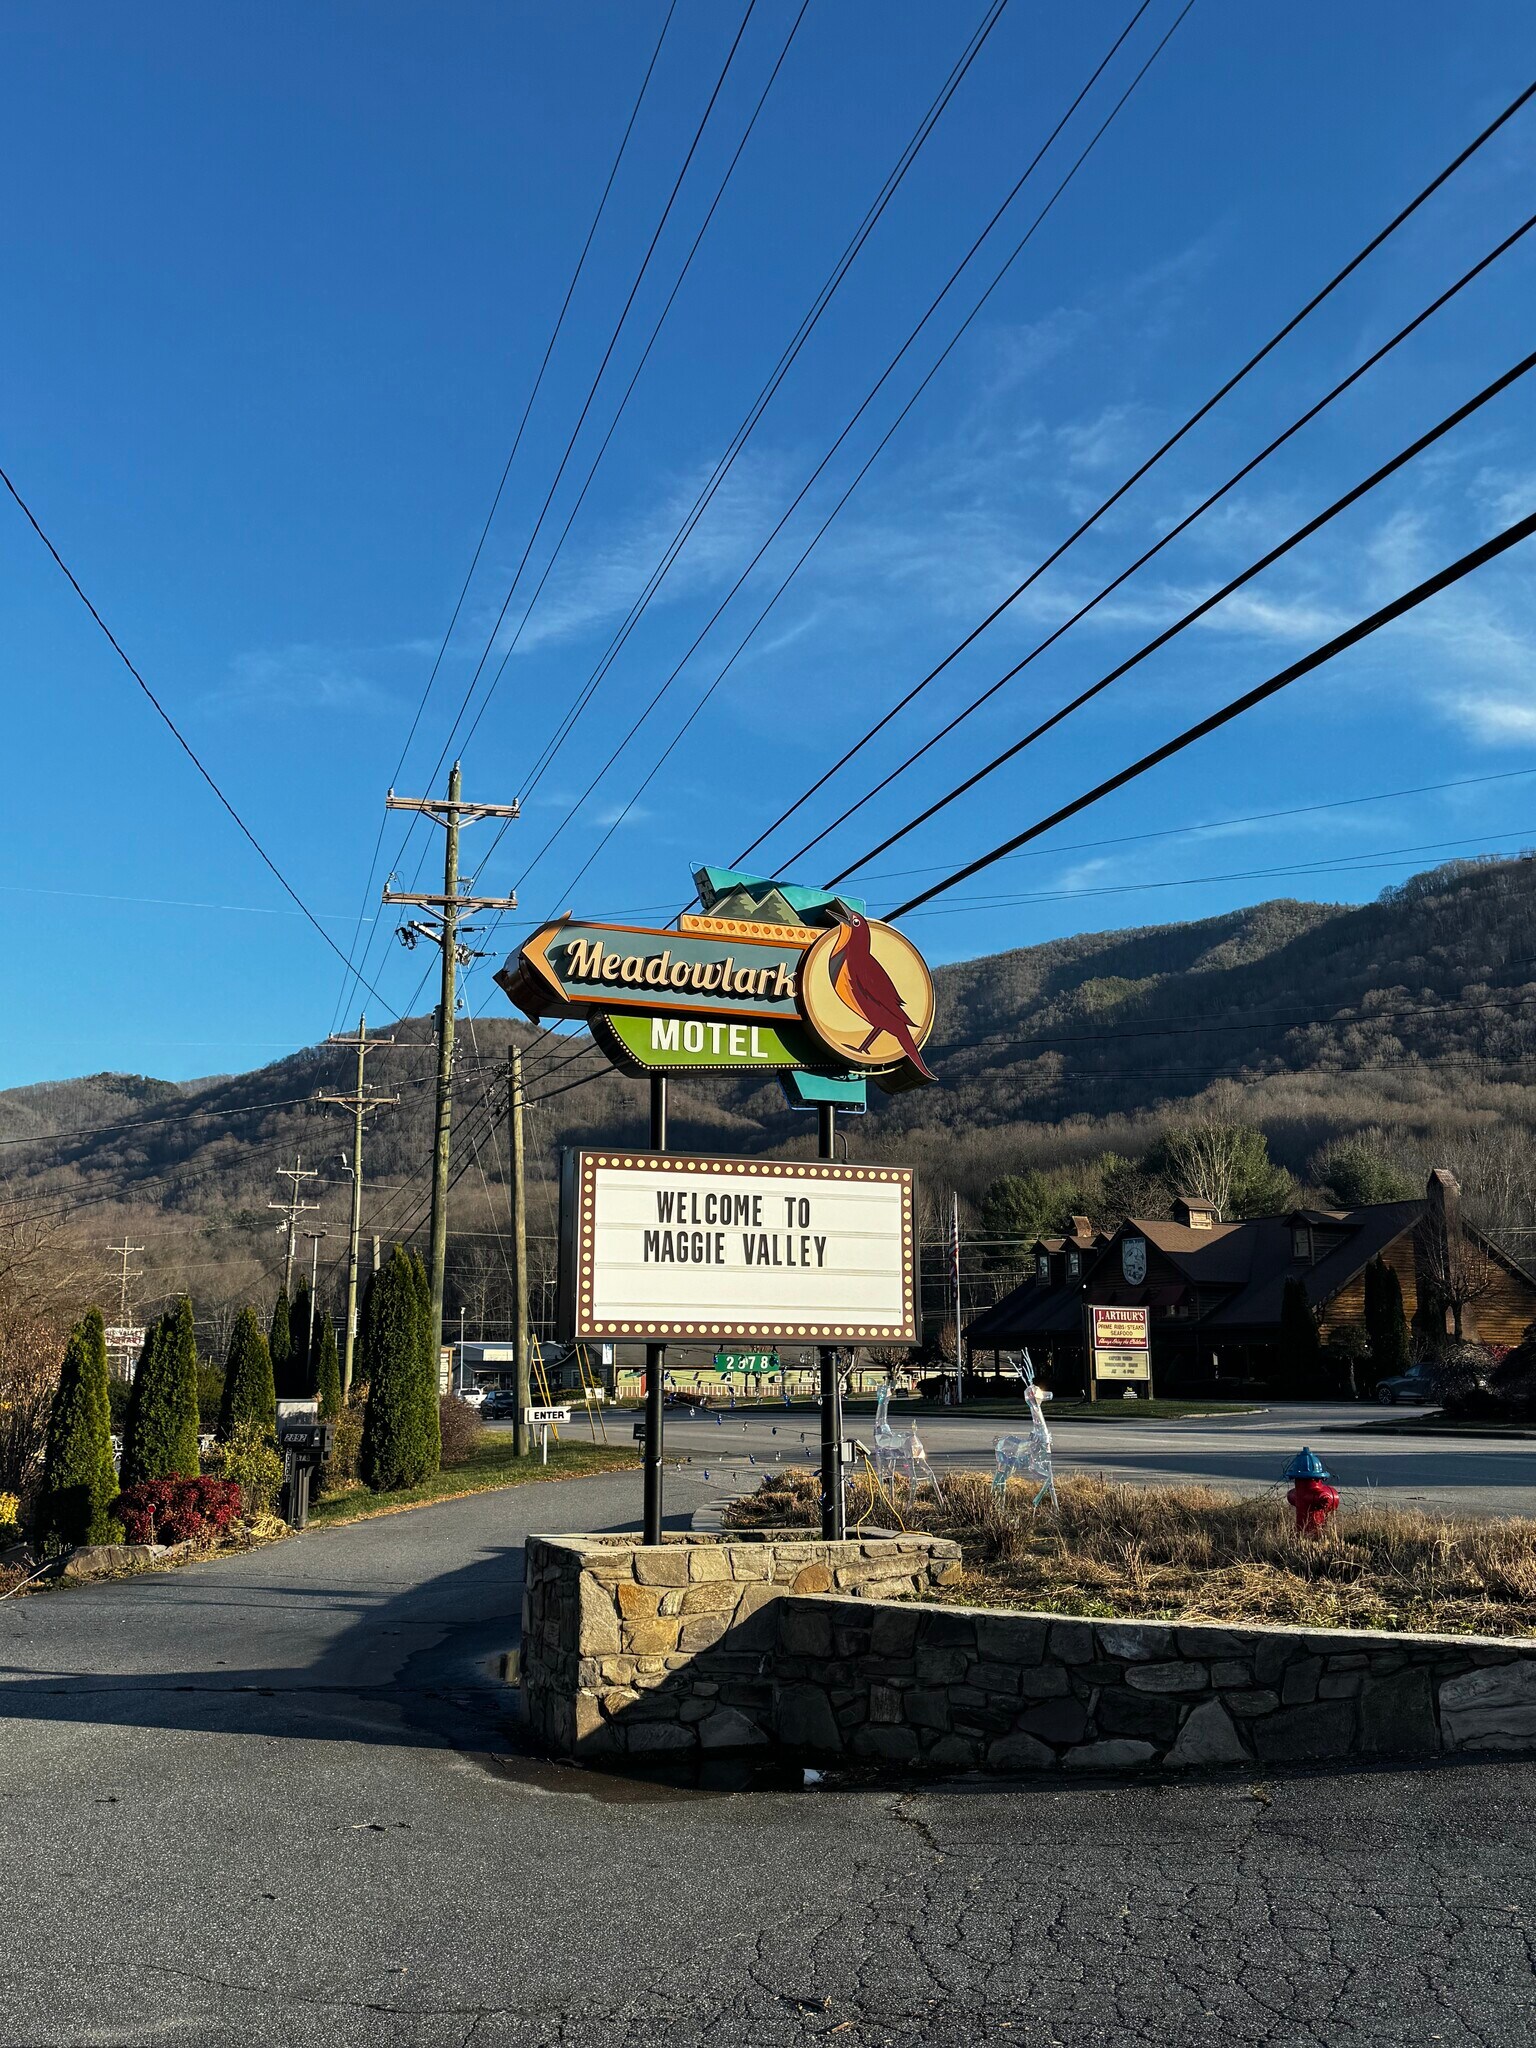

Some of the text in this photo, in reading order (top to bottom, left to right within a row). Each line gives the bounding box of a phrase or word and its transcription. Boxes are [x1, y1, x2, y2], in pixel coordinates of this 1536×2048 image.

[567, 938, 798, 998] Meadowlark
[650, 1017, 769, 1059] MOTEL
[656, 1191, 810, 1229] WELCOME TO
[643, 1230, 827, 1267] MAGGIE VALLEY
[1098, 1311, 1144, 1321] J. ARTHUR'S
[534, 1411, 565, 1420] ENTER
[284, 1434, 307, 1442] 2892
